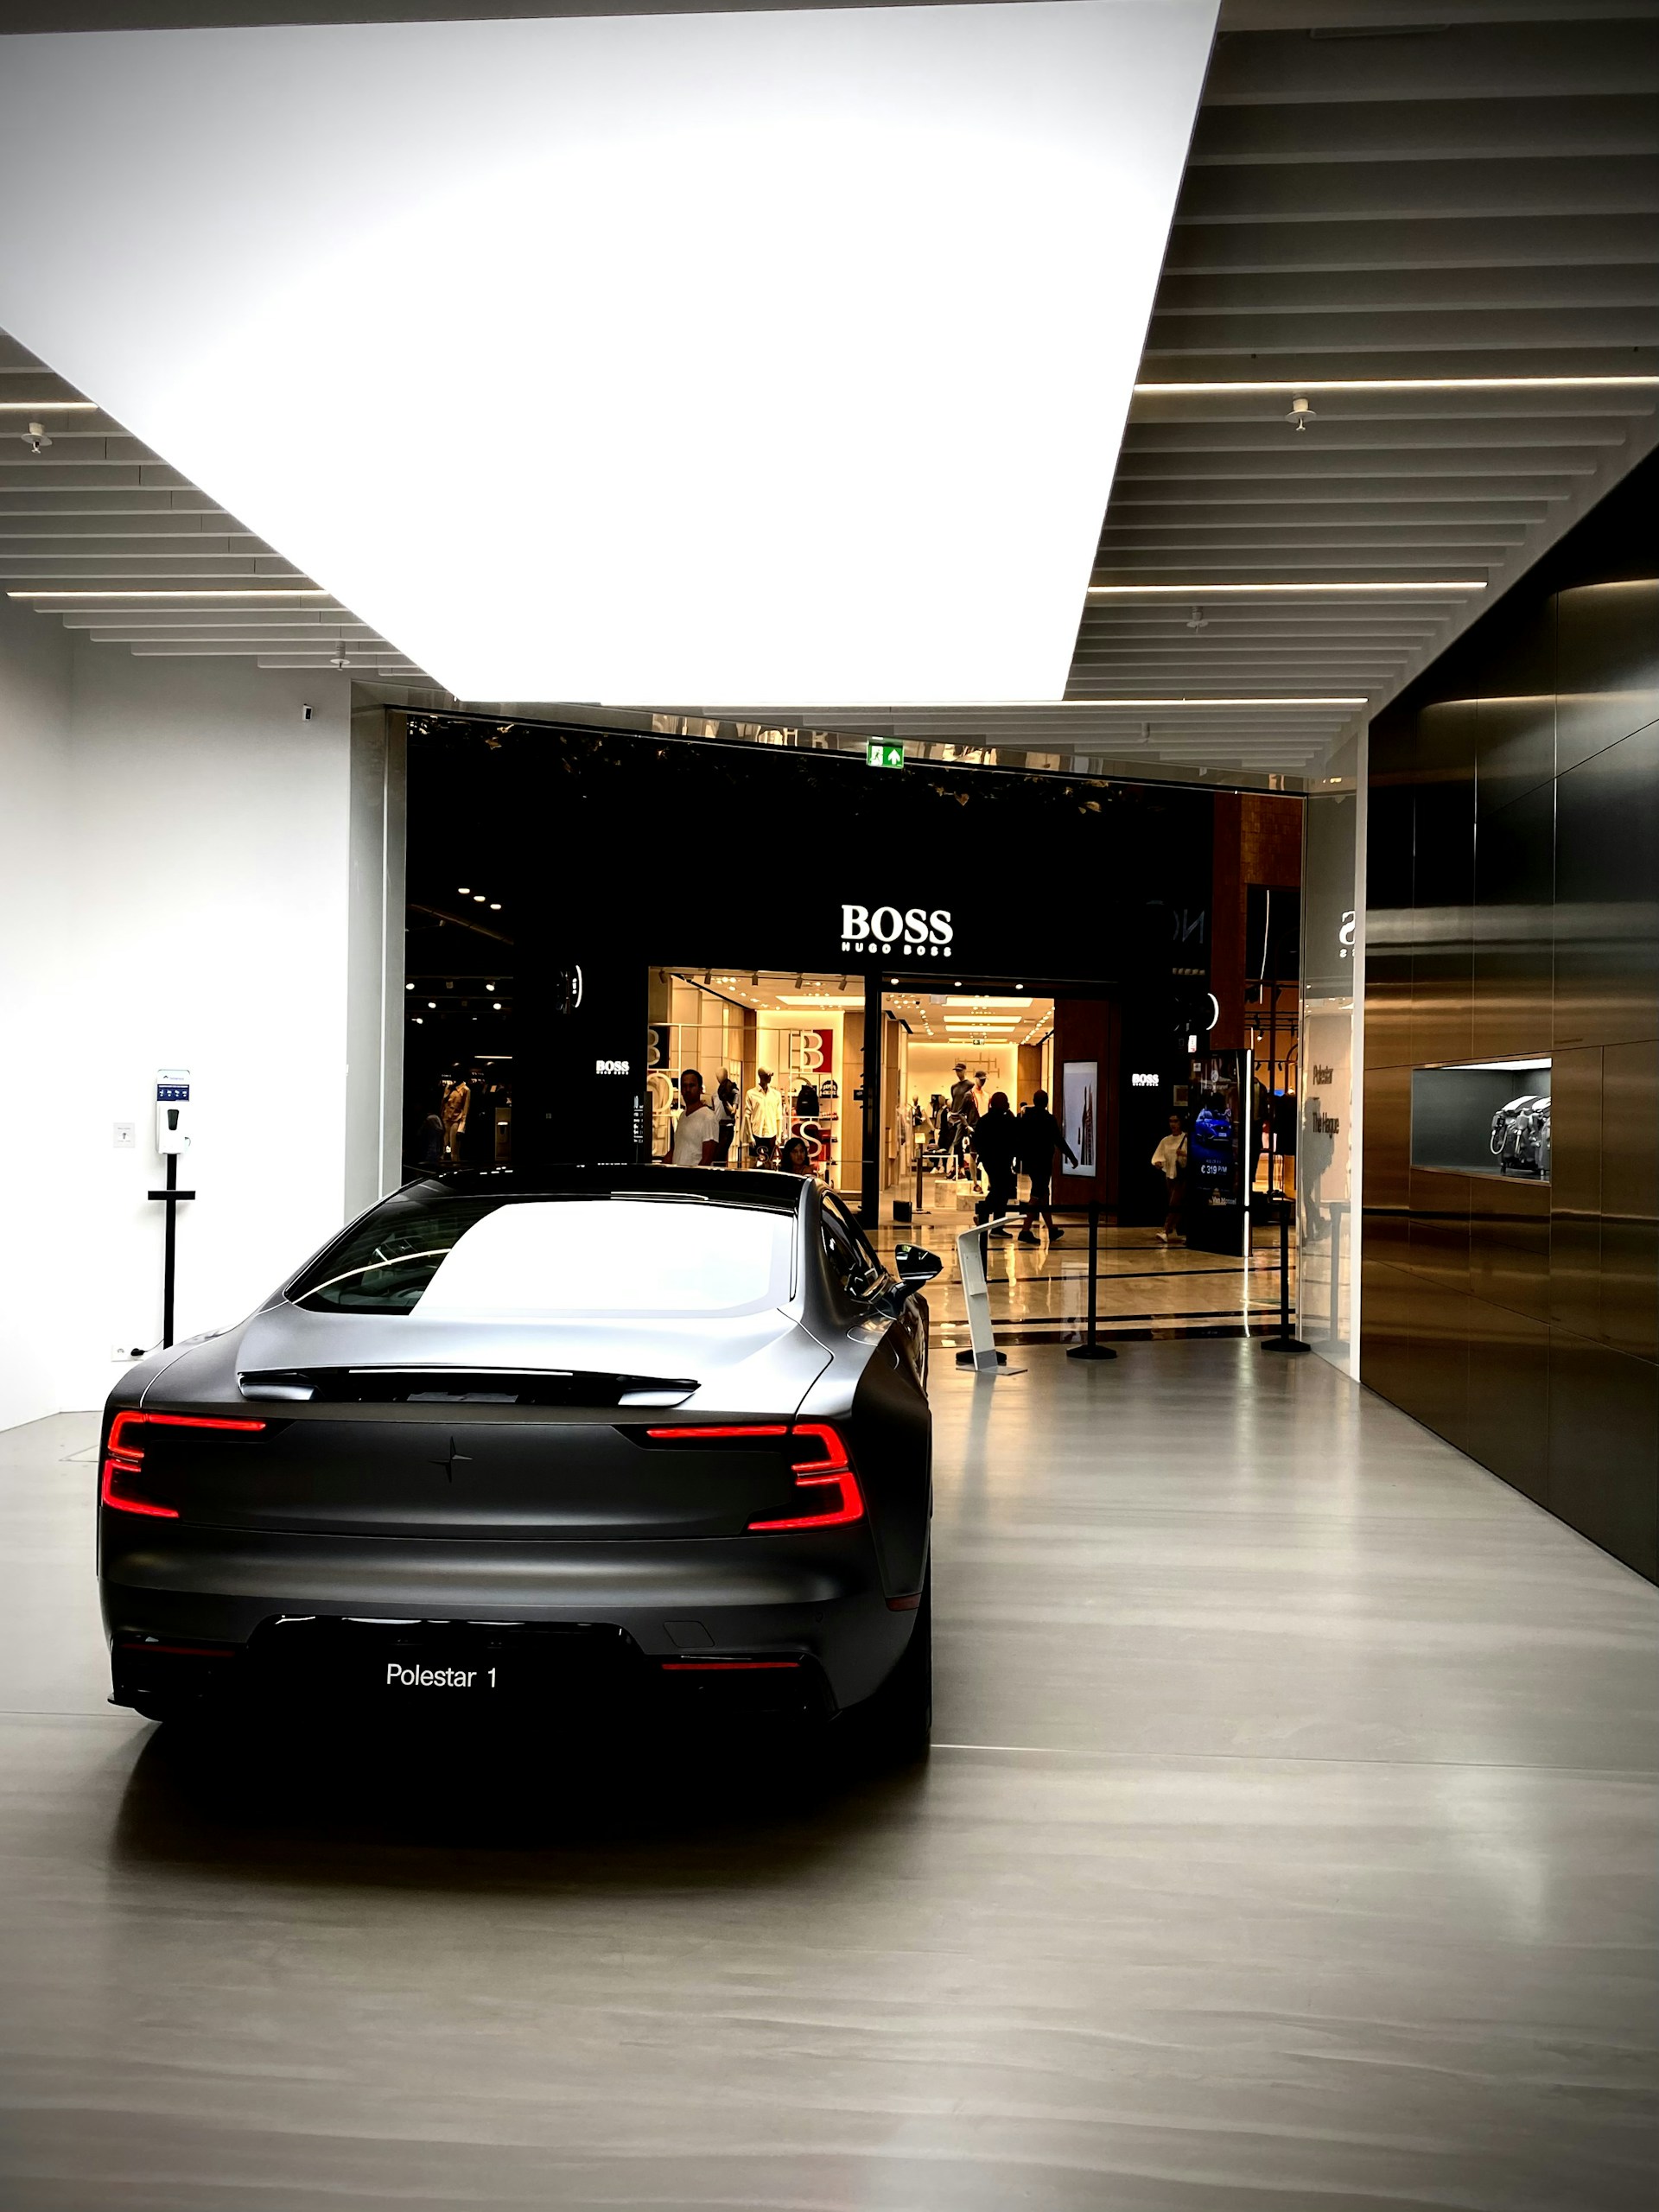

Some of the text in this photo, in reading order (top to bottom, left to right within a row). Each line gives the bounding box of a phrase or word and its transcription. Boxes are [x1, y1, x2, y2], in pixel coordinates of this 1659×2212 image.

[841, 905, 953, 944] BOSS
[842, 942, 951, 957] HUGO BOSS
[596, 1060, 630, 1071] BOSS
[1132, 1073, 1159, 1084] BOSS
[1313, 1065, 1333, 1085] Polestar
[1313, 1112, 1339, 1139] The Hague
[1206, 1165, 1217, 1174] 319
[387, 1663, 496, 1688] Polestar 1
